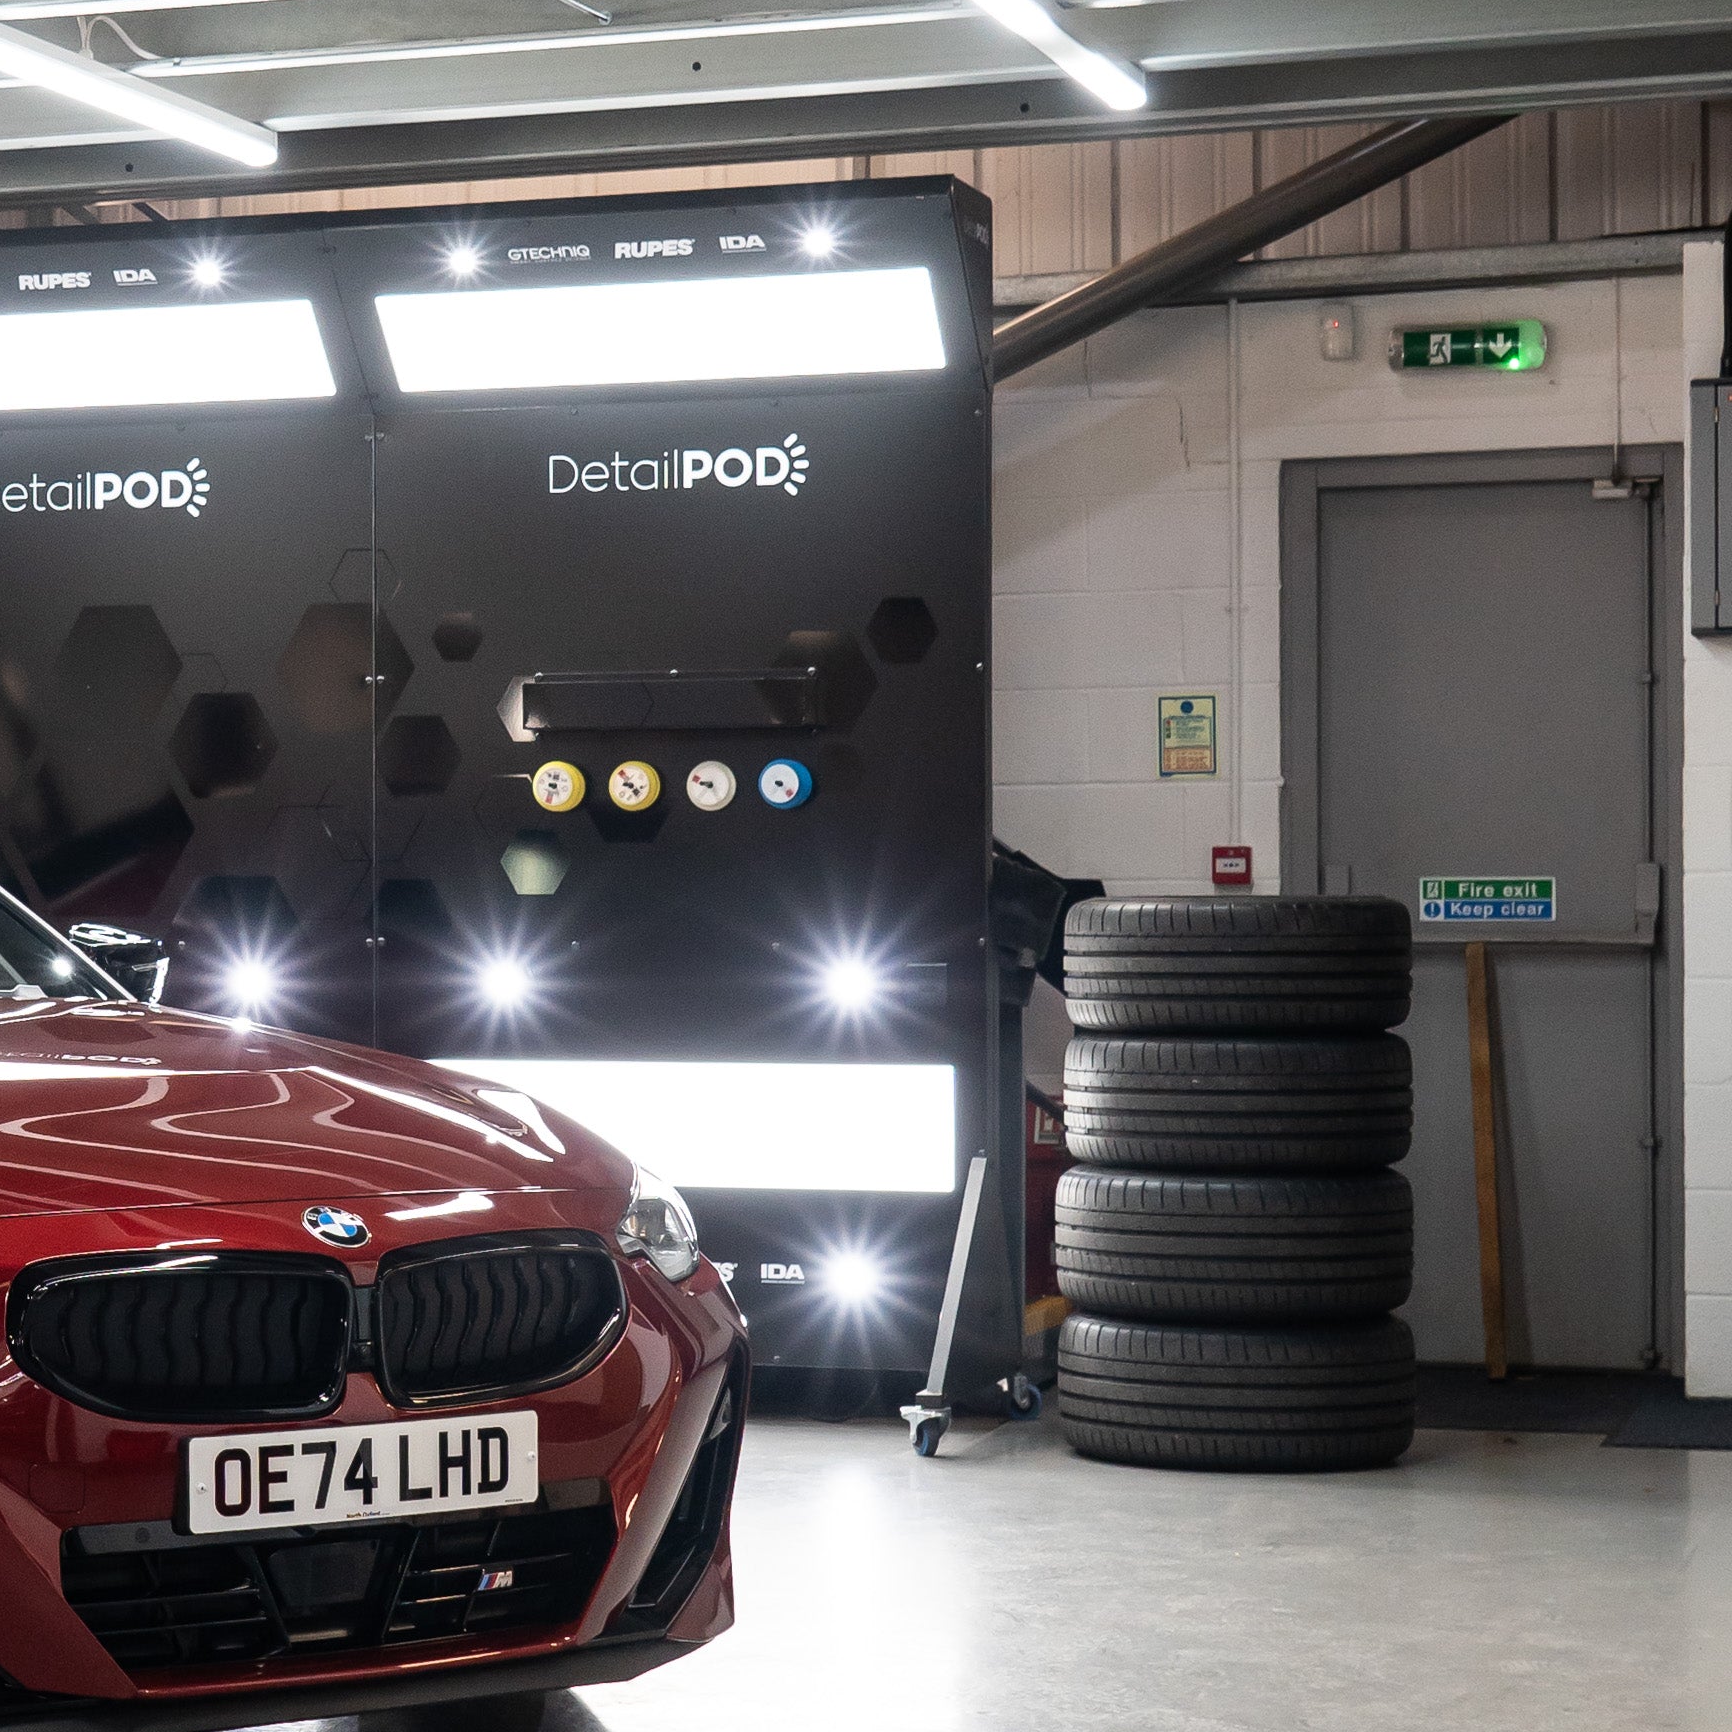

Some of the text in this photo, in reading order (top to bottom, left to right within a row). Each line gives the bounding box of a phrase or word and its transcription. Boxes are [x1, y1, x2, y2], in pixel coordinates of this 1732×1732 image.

[615, 238, 695, 259] RUPES
[719, 235, 767, 251] IDA
[18, 272, 91, 290] RUPES
[113, 268, 157, 284] IDA
[548, 447, 791, 494] DetailPOD
[1458, 881, 1538, 898] Fire exit
[1450, 901, 1544, 919] Keep clear
[760, 1262, 805, 1281] IDA
[214, 1425, 509, 1517] OE74 LHD
